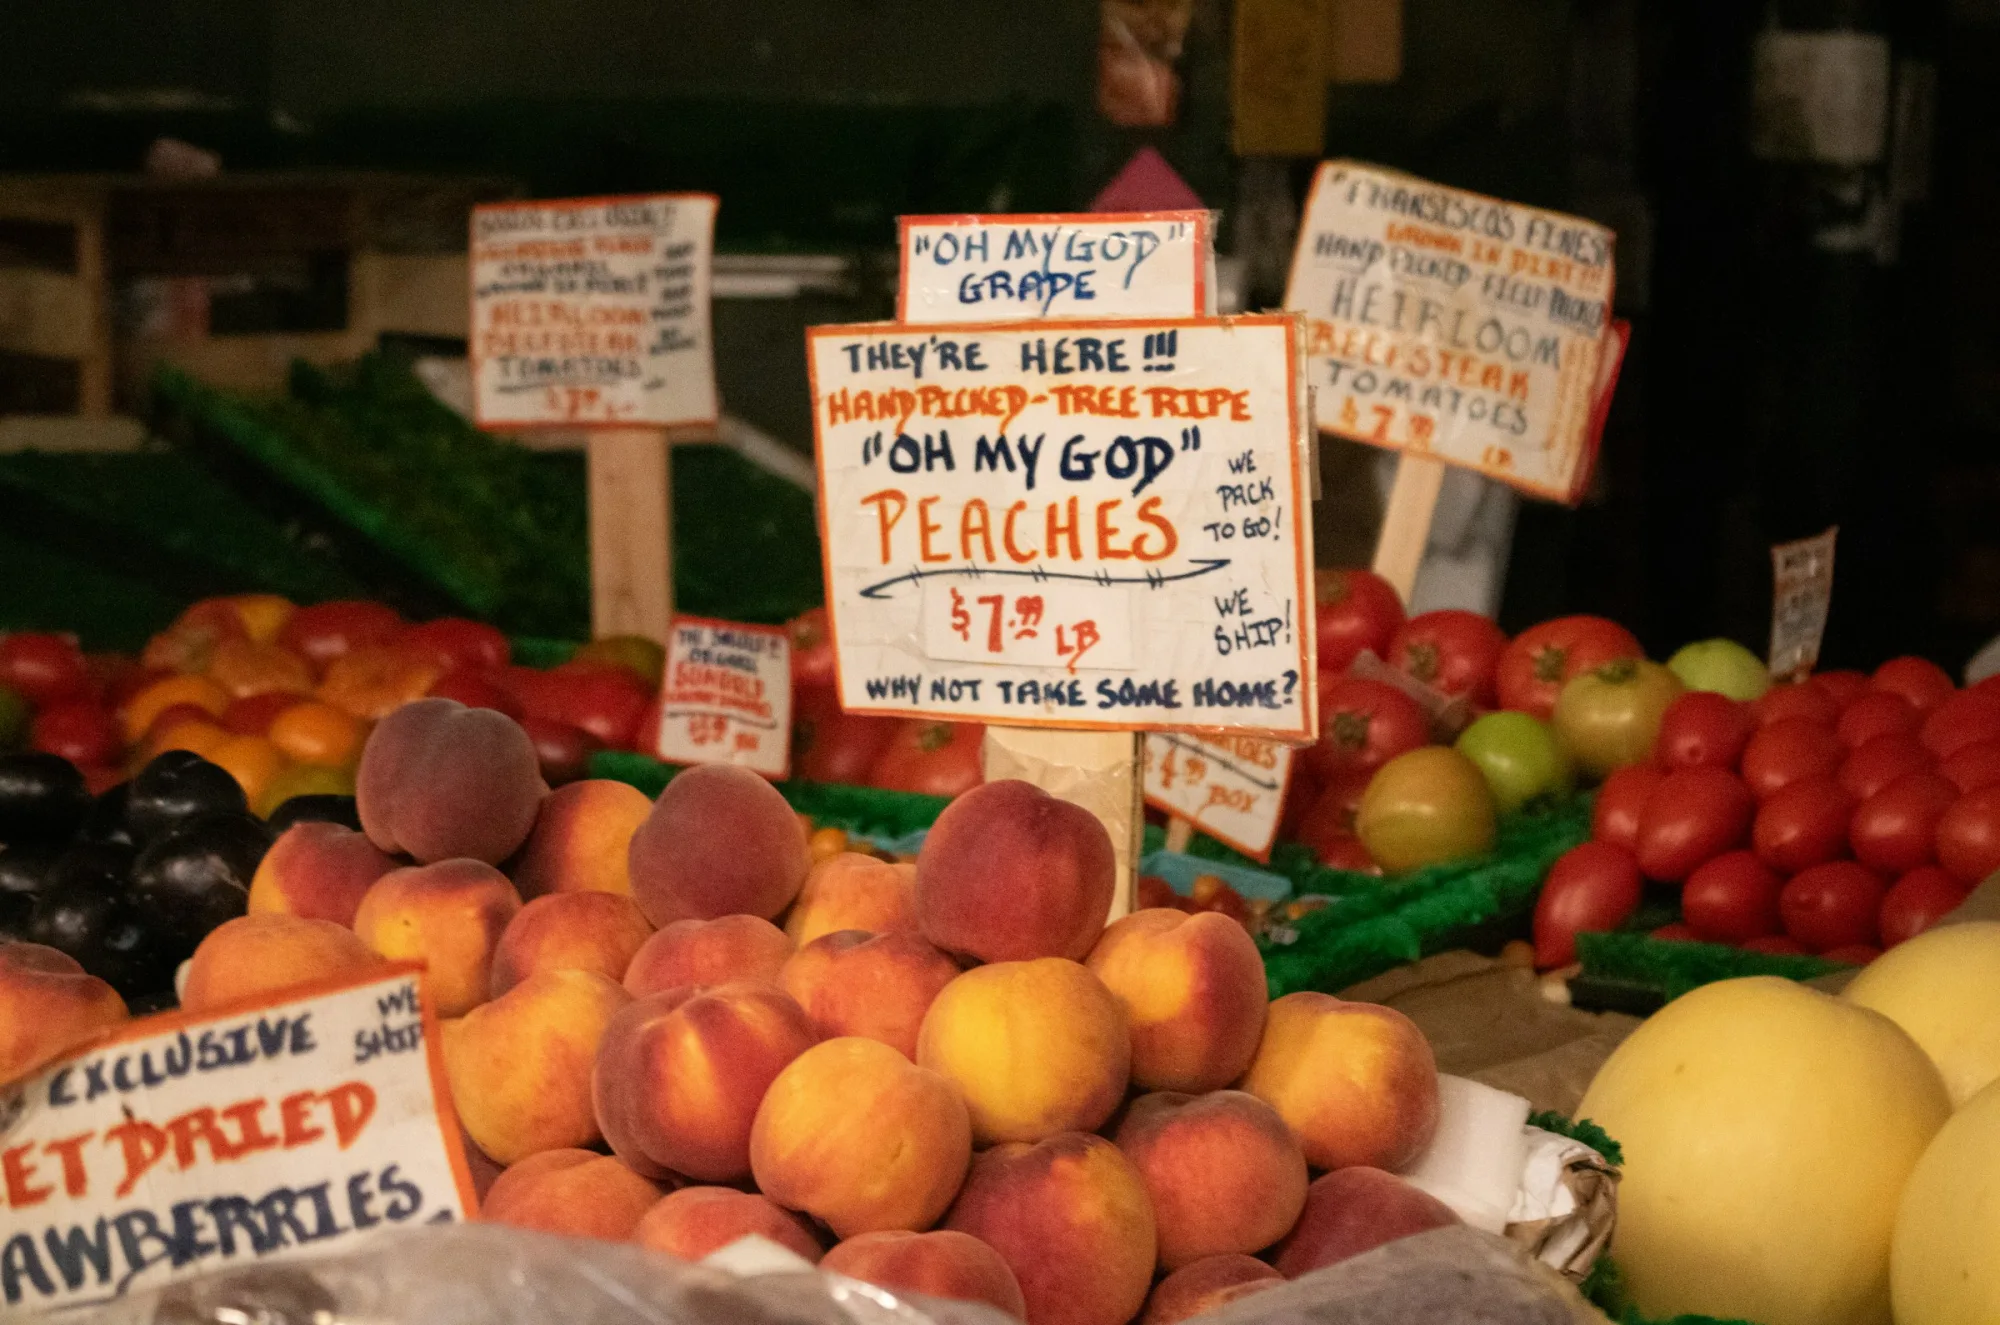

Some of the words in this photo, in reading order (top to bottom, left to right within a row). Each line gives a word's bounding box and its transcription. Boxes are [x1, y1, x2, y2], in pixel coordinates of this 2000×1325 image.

[1005, 226, 1060, 280] MY
[958, 270, 1097, 316] GRADE
[1332, 279, 1560, 370] HEIRLOOM
[841, 336, 989, 378] THEY'RE
[1022, 338, 1131, 374] HERE
[1326, 359, 1528, 435] TOMATOES
[862, 429, 956, 475] "OH
[974, 432, 1046, 491] MY
[1060, 426, 1201, 497] GOD"
[1226, 449, 1257, 475] WE
[1216, 476, 1275, 511] PACK
[860, 488, 1180, 566] PEACHES
[1203, 521, 1235, 543] TO
[1241, 506, 1284, 542] GO!
[1213, 598, 1294, 656] SHIP!
[1214, 590, 1255, 620] WE
[1056, 622, 1101, 675] LB
[866, 673, 923, 701] WHY
[931, 676, 983, 703] NOT
[998, 680, 1087, 707] TAKE
[1096, 679, 1183, 710] SOME
[1192, 670, 1300, 711] HOME?
[377, 981, 424, 1015] WE
[48, 1012, 317, 1107] EXCLUSIVE
[0, 1131, 95, 1210] ET
[105, 1081, 378, 1198] DRIED
[1, 1163, 425, 1302] AWBERRIES
